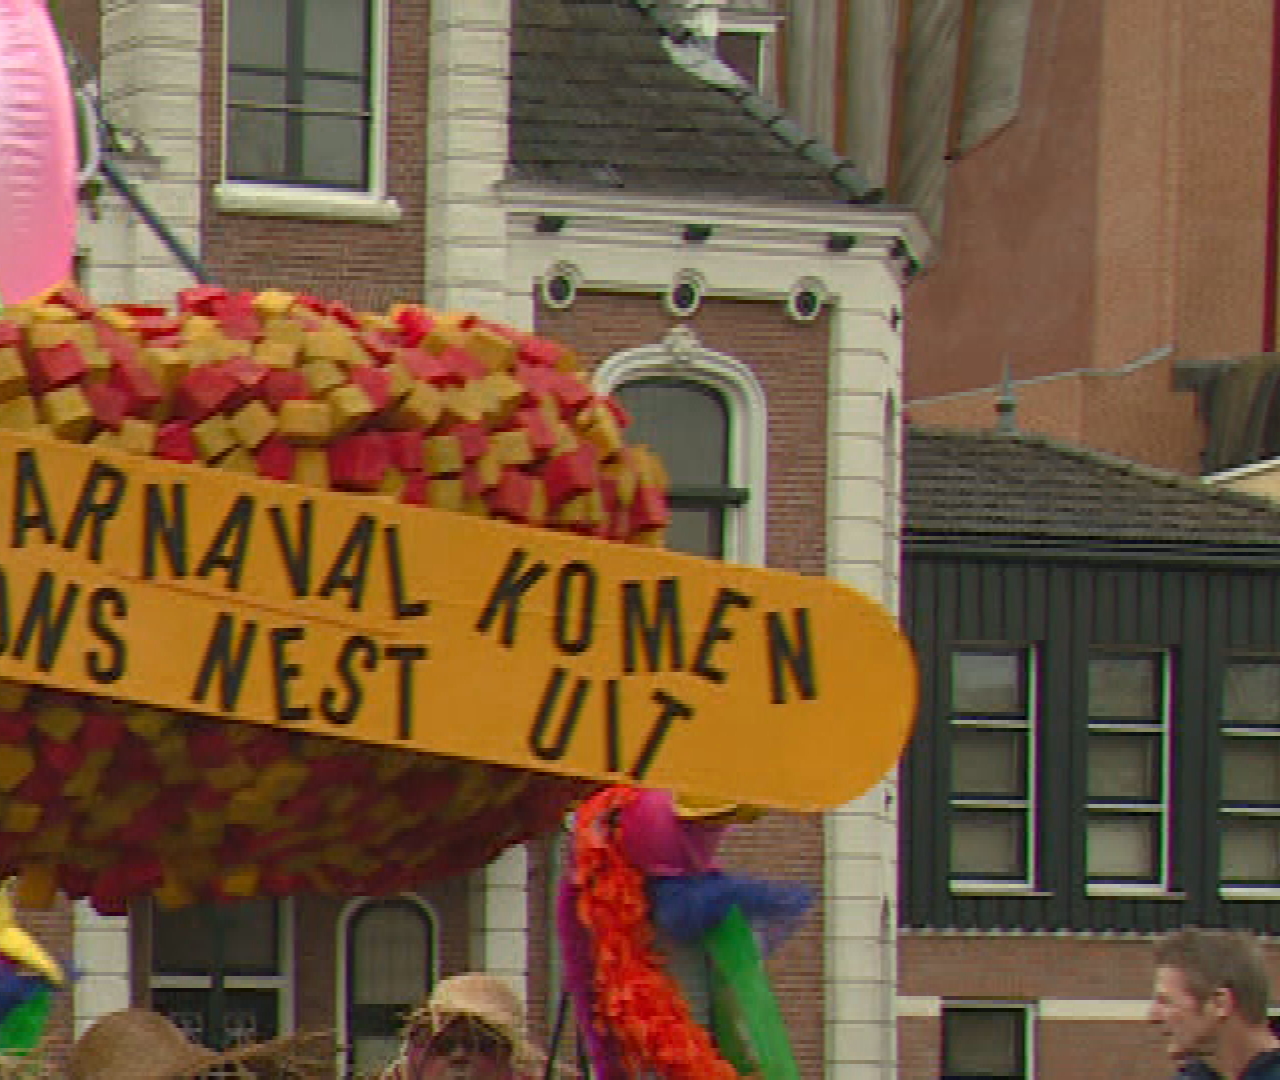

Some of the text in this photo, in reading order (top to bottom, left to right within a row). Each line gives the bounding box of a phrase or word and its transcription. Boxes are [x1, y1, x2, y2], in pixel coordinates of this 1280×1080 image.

[191, 611, 431, 741] NEST
[527, 666, 696, 781] UIT
[474, 546, 819, 705] KOMEN
